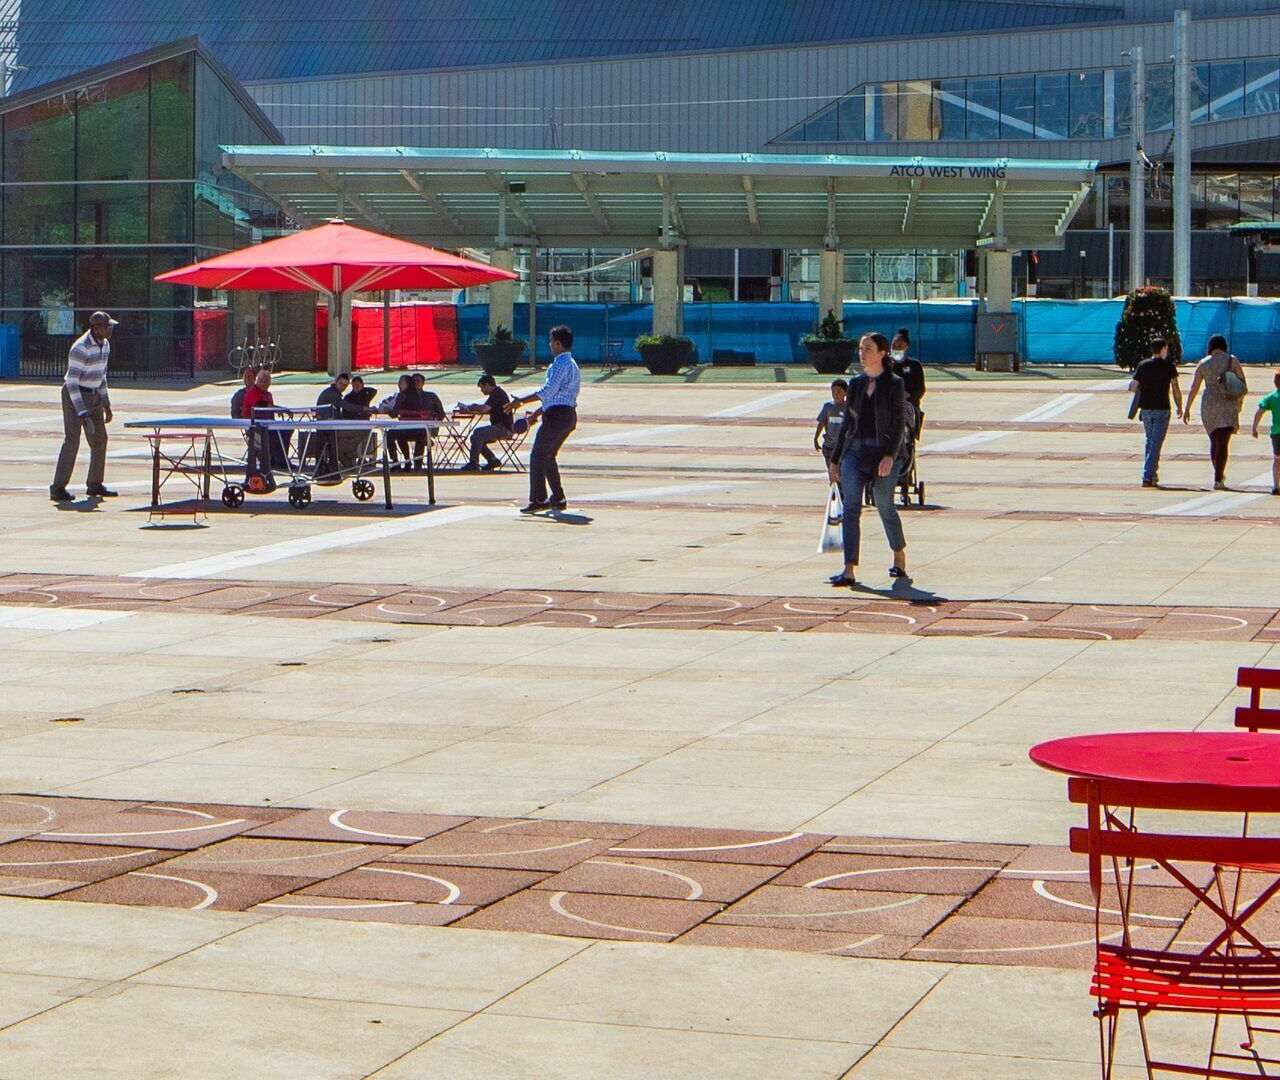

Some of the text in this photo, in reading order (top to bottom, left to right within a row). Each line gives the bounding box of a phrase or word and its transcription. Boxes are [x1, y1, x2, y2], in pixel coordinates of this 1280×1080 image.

[889, 165, 1006, 179] ATCO WEST WING
